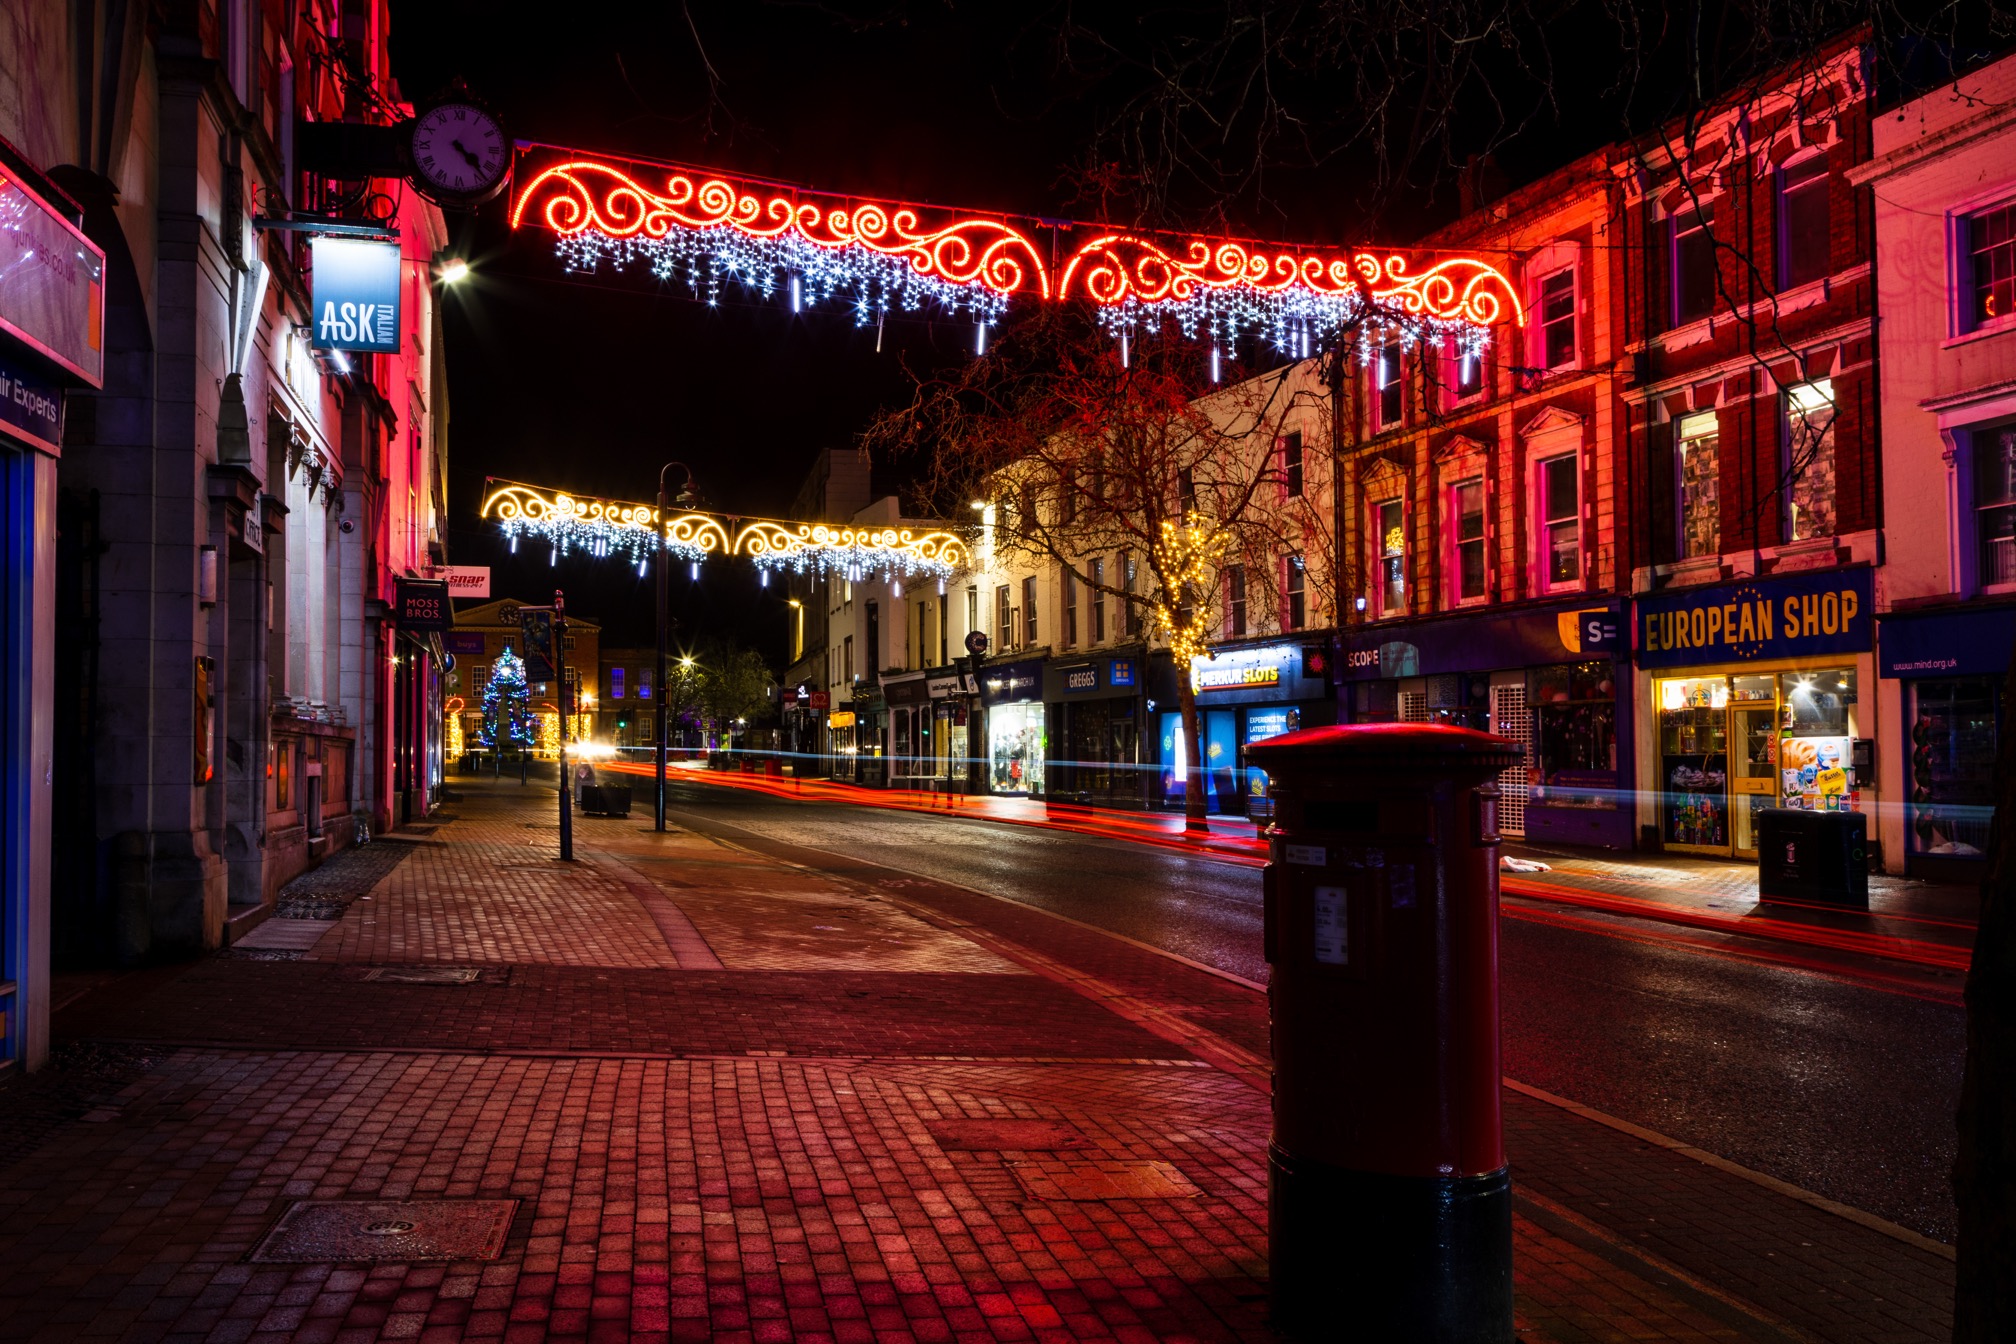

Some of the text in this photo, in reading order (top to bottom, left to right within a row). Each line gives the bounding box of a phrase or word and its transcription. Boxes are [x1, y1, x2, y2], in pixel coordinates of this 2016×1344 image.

[320, 301, 375, 342] ASK
[377, 304, 394, 343] ITALIAN
[14, 378, 57, 423] Experts
[449, 575, 485, 584] snap
[406, 598, 439, 608] MOSS
[406, 610, 442, 619] BROS.
[1645, 589, 1859, 652] EUROPEAN SHOP
[1348, 650, 1379, 667] SCOPE
[1893, 658, 1957, 670] www.mind.org.uk
[1069, 671, 1095, 688] GREGGS
[1200, 666, 1278, 686] MERKUR SLOTS
